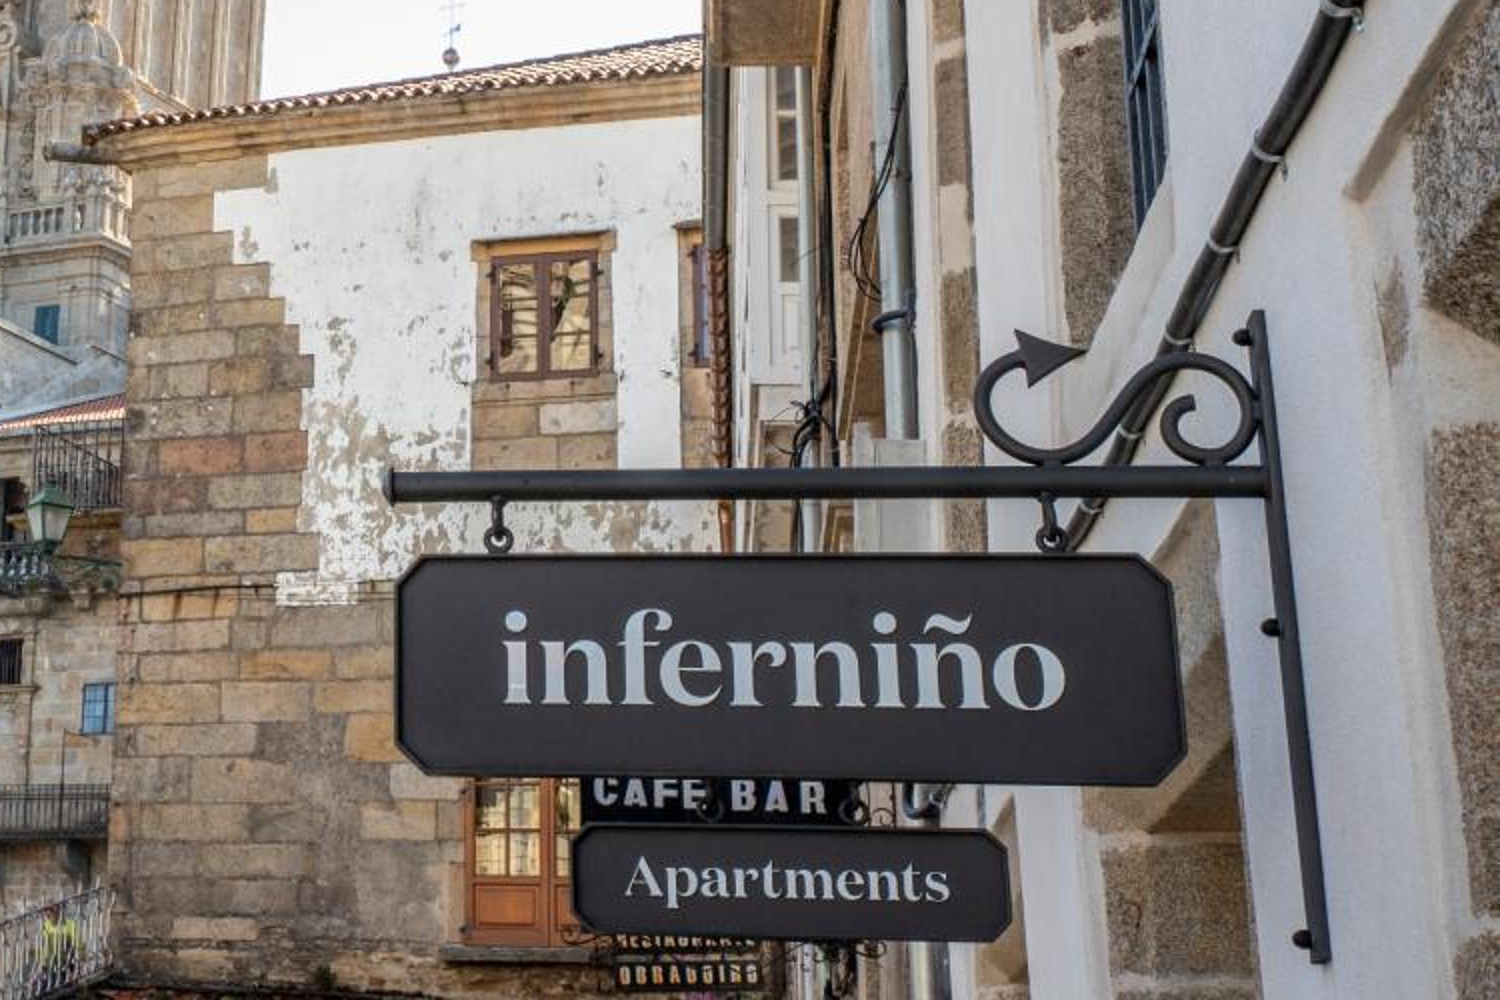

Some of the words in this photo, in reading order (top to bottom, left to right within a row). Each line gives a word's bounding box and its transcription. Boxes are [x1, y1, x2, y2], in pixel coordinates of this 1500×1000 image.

[502, 608, 1066, 711] inferniño
[731, 779, 827, 814] BAR
[624, 855, 951, 908] Apartments
